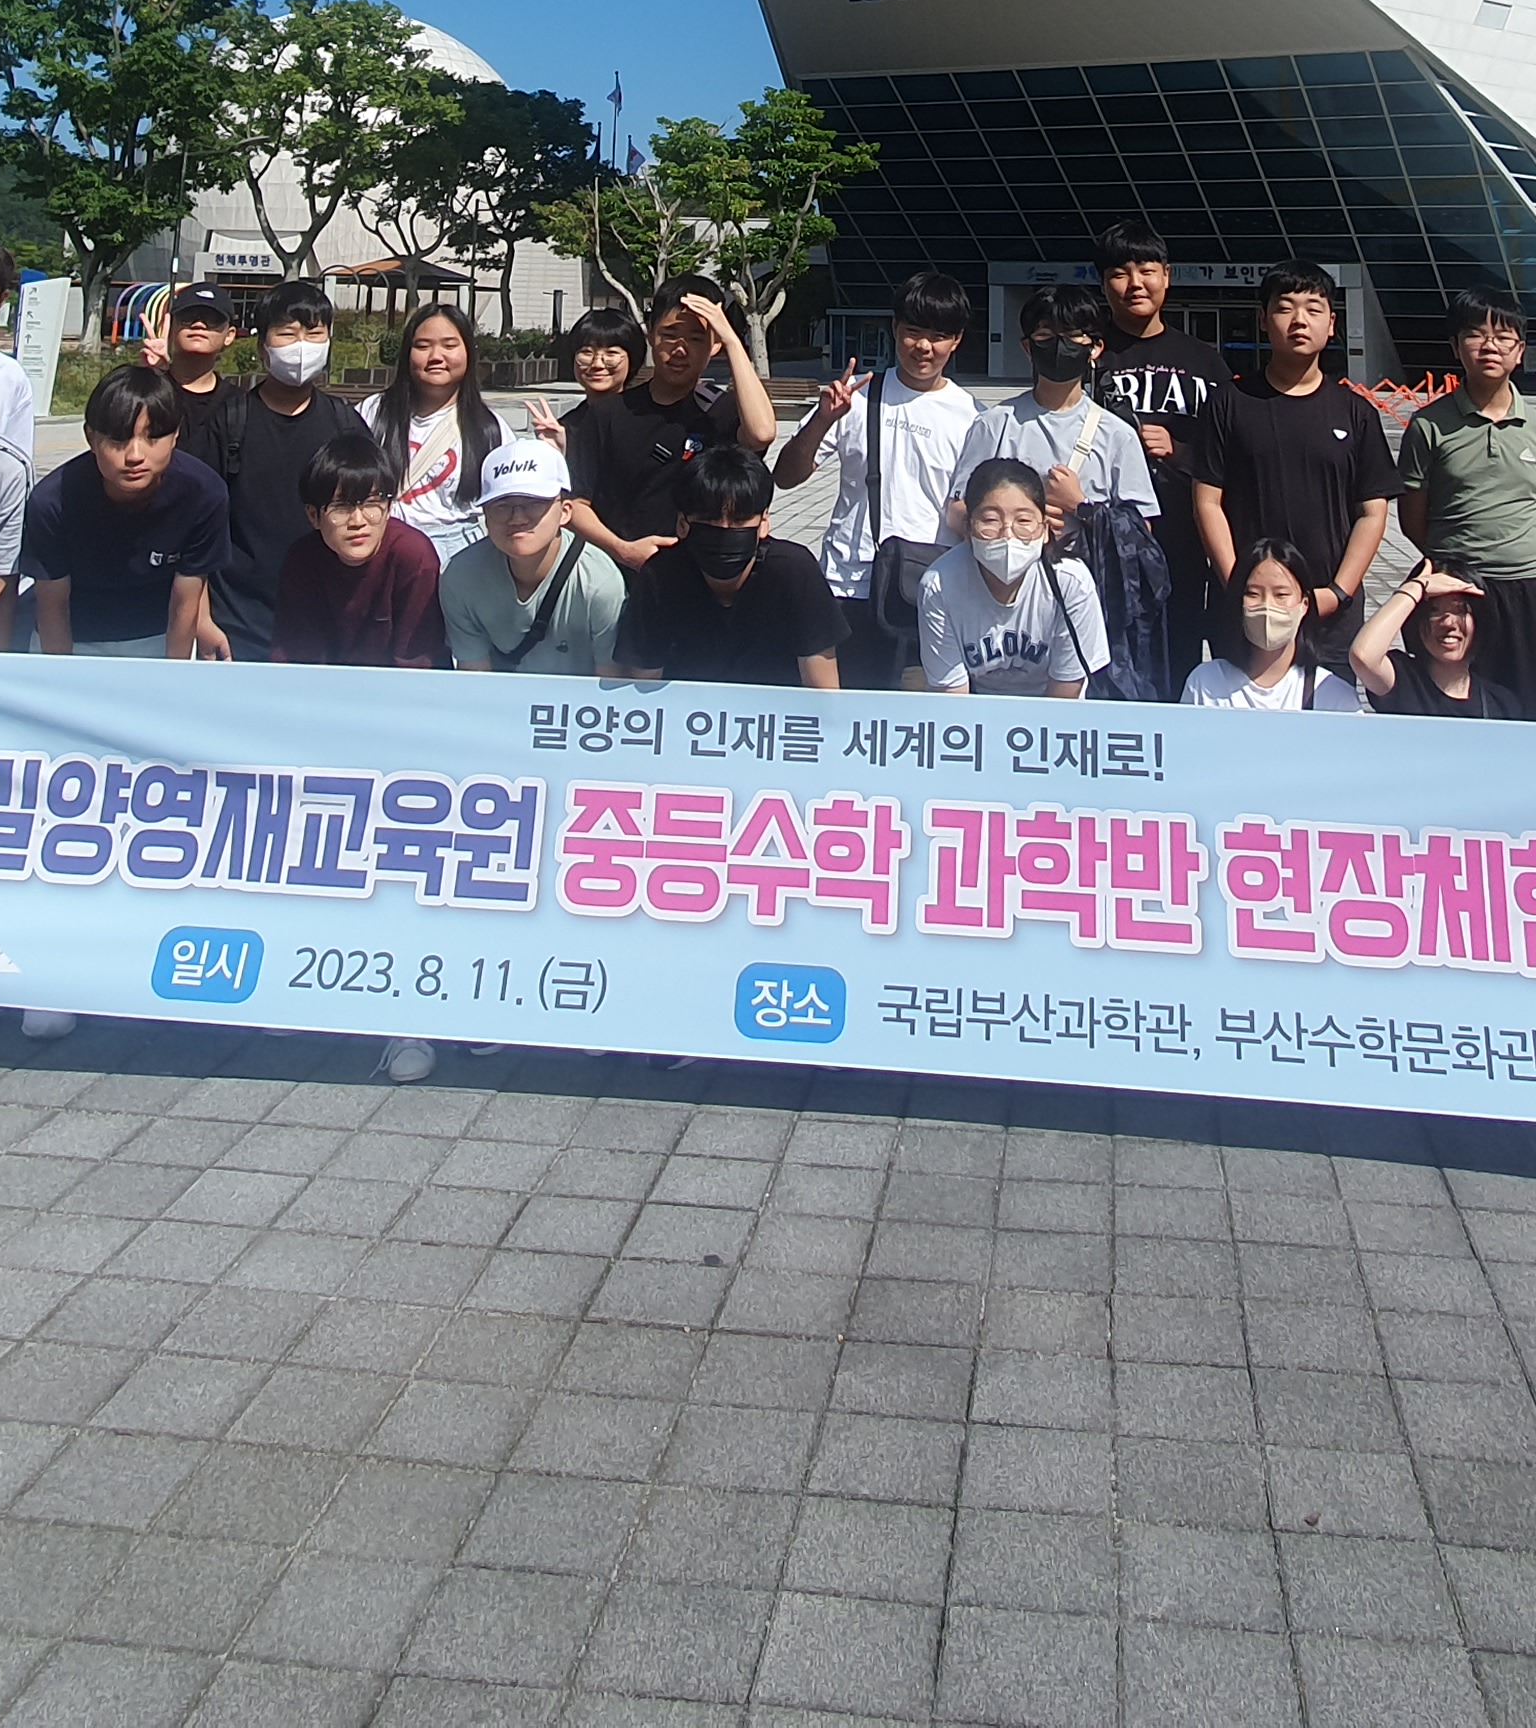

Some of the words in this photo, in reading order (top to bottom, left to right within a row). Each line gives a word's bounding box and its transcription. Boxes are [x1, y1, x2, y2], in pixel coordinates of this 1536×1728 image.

[215, 253, 271, 268] 천체투영관
[492, 459, 538, 480] Volvik
[963, 629, 1049, 668] GLOW
[529, 703, 665, 756] 밀양의
[684, 710, 825, 764] 인재를
[841, 719, 984, 773] 세계의
[1005, 725, 1165, 782] 인재로!
[561, 786, 904, 930] 중등수학
[923, 806, 1202, 949] 과학반
[170, 938, 251, 990] 일시
[288, 946, 401, 999] 2023.
[750, 978, 833, 1029] 장소
[876, 983, 1202, 1062] 국립부산과학관,
